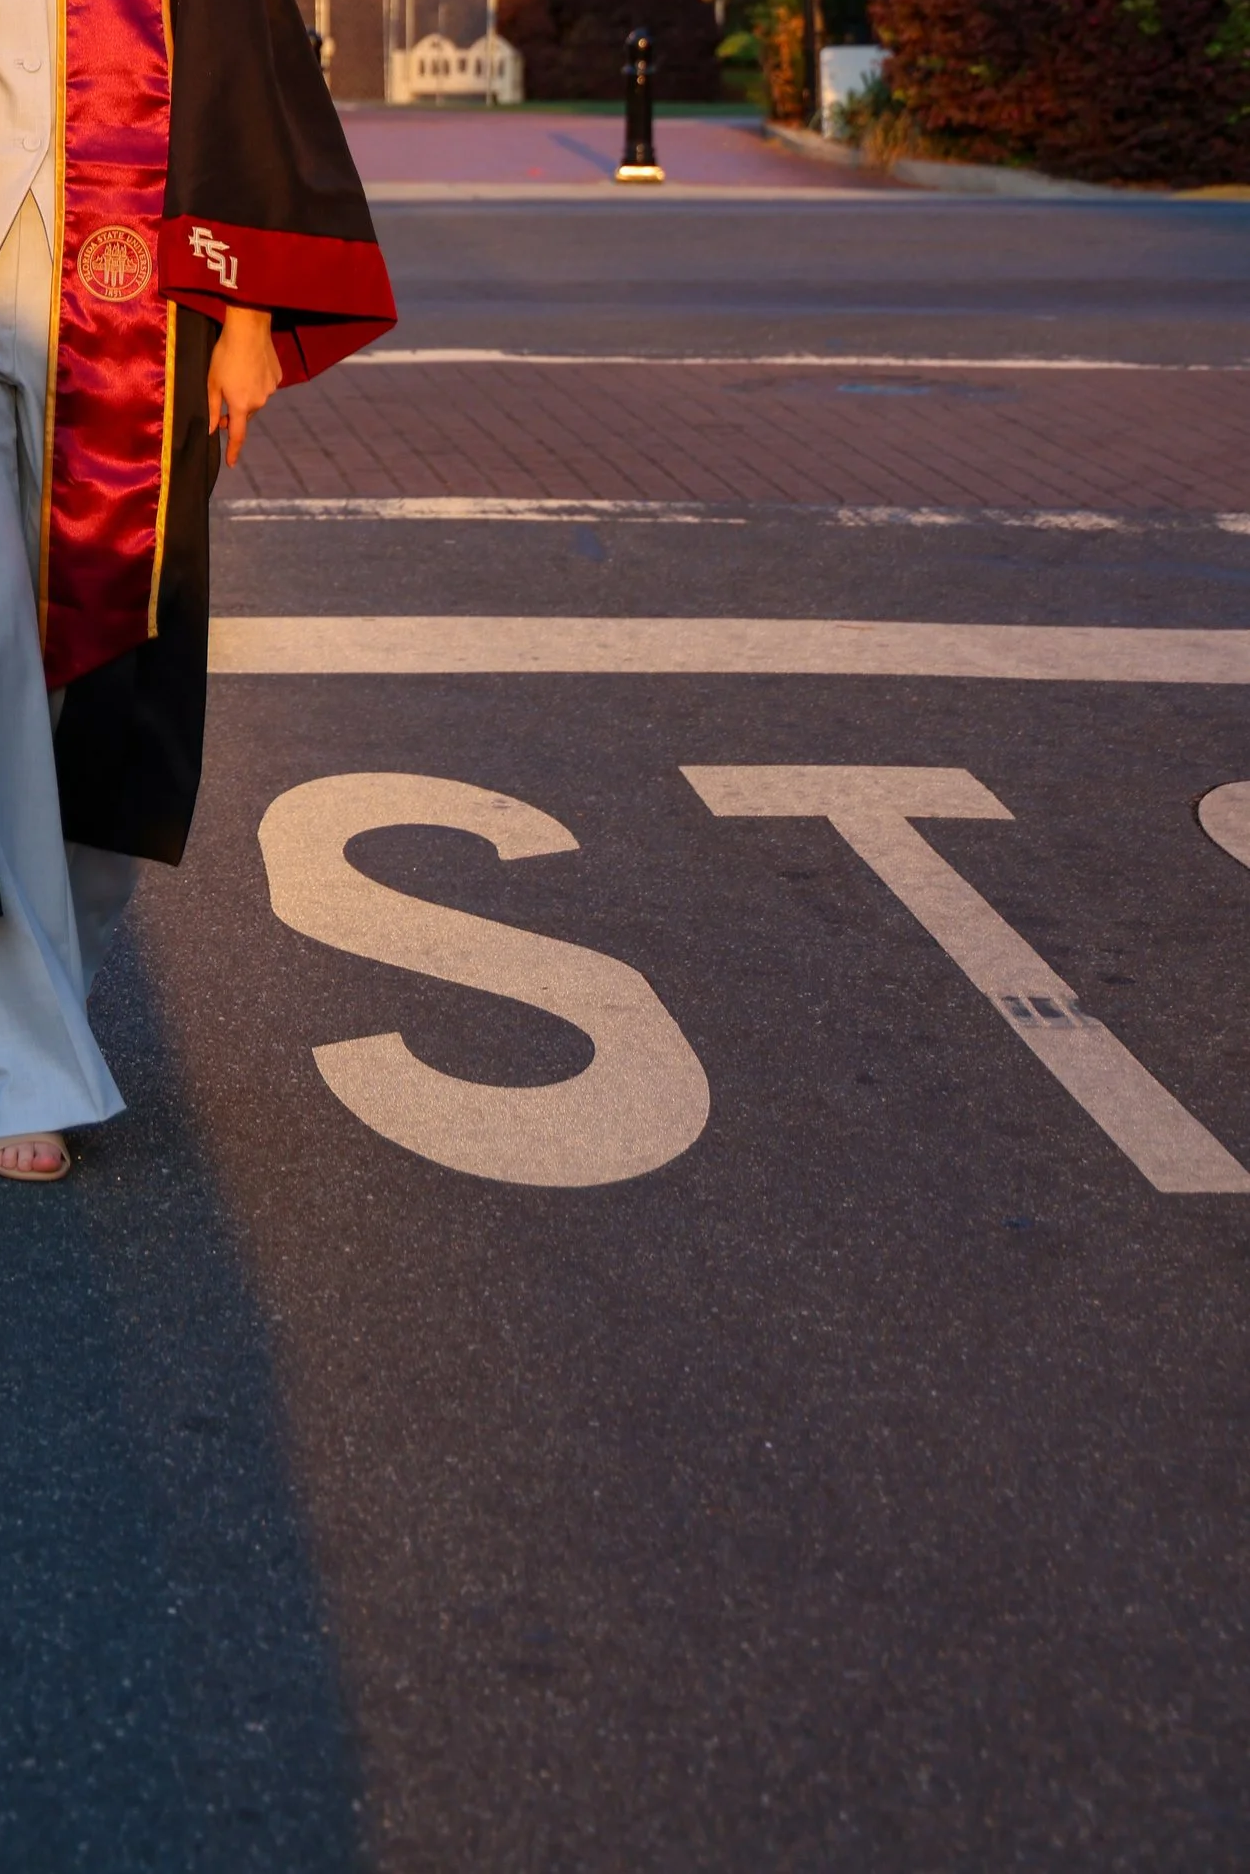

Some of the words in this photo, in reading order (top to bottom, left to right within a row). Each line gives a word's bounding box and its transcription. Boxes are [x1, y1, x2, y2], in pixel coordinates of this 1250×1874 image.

[82, 241, 98, 283] FLORIDA
[97, 230, 125, 243] STATE
[126, 234, 147, 286] UNIVERSITY
[188, 226, 238, 289] FSU
[257, 765, 1250, 1193] ST
